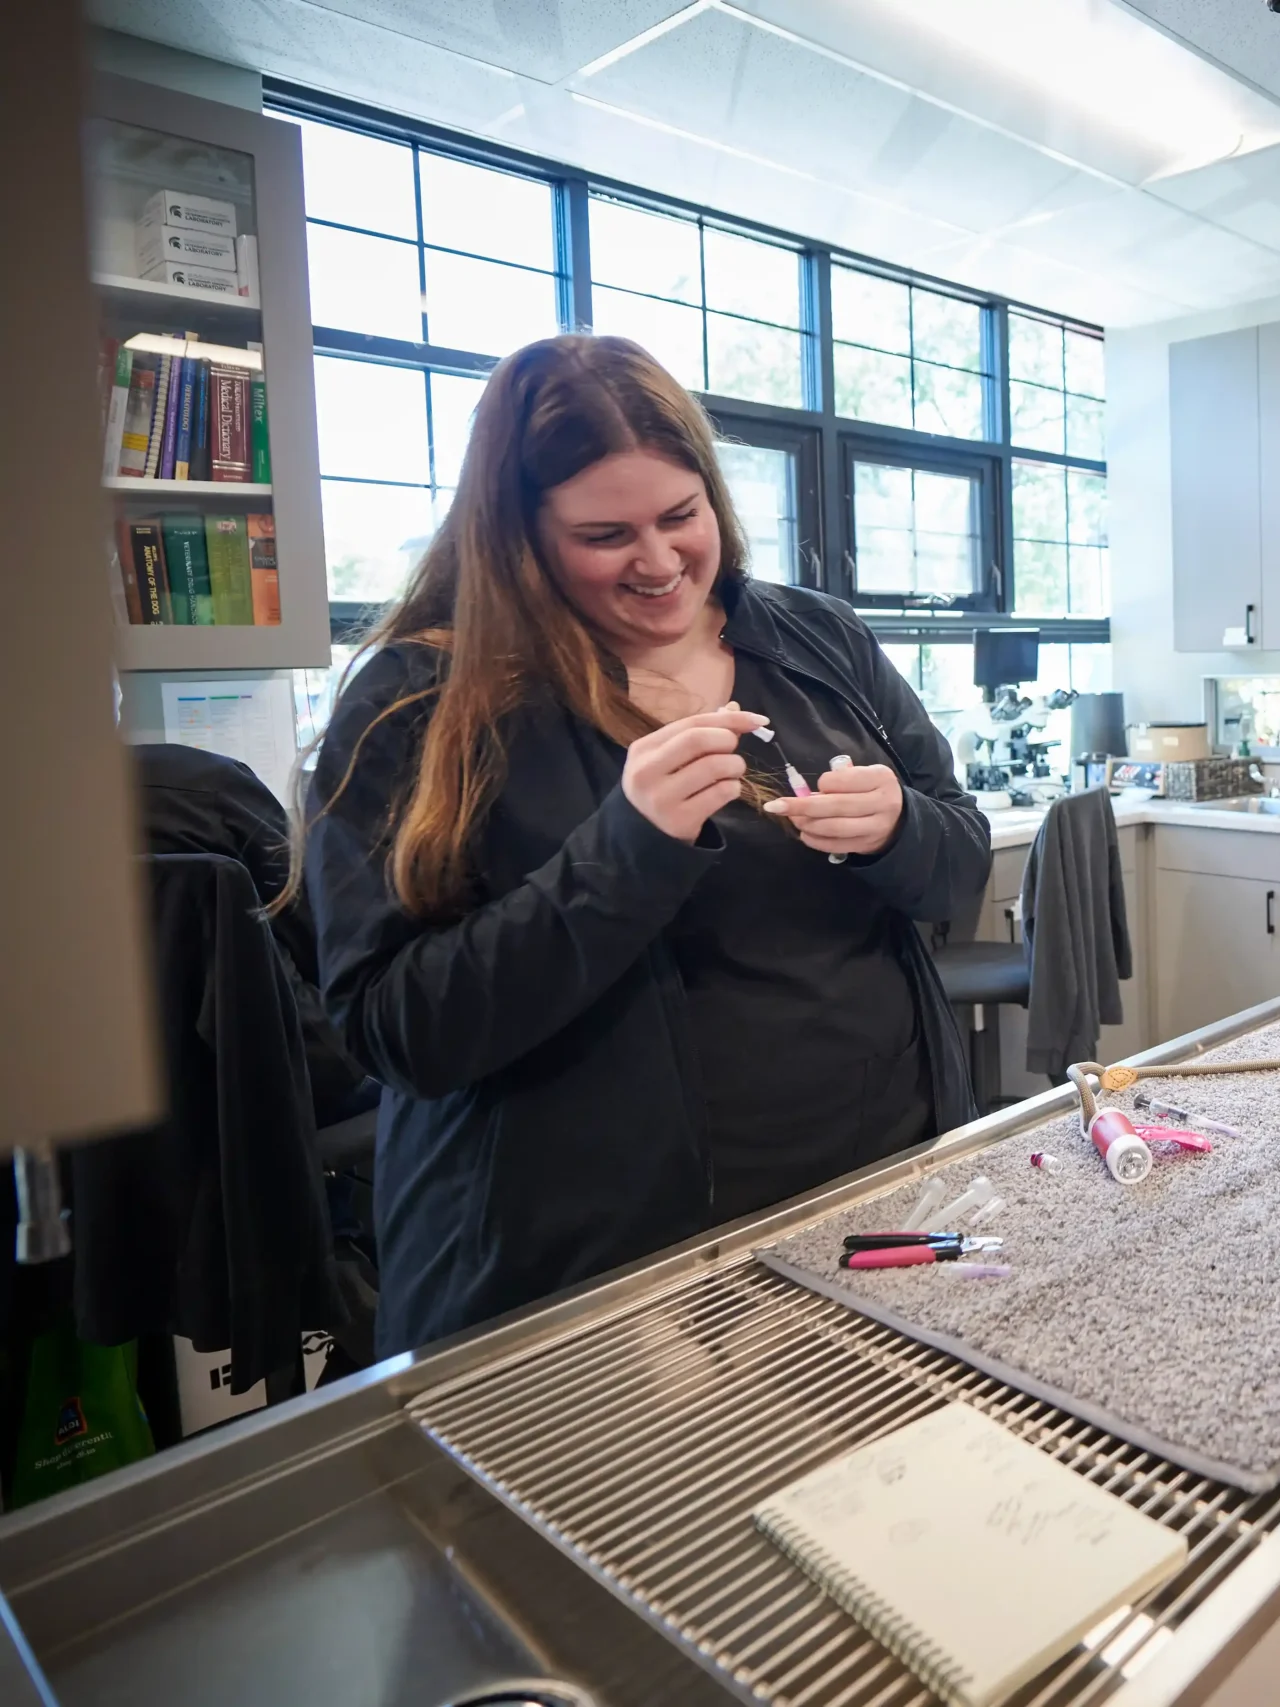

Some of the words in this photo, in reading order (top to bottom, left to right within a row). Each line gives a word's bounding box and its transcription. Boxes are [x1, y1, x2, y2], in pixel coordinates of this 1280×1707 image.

[185, 215, 223, 227] LABORATORY
[184, 247, 222, 257] LABORATORY
[188, 281, 226, 292] LABORATORY
[220, 379, 233, 413] Medical
[253, 387, 265, 425] Miltex
[219, 413, 232, 460] Dictionary
[143, 545, 155, 577] ANATOMY
[183, 541, 194, 576] VETERINARY
[148, 577, 156, 588] OF
[149, 586, 158, 600] THE
[151, 600, 160, 615] DOG
[58, 1419, 81, 1436] ALDI
[34, 1454, 62, 1470] Shop
